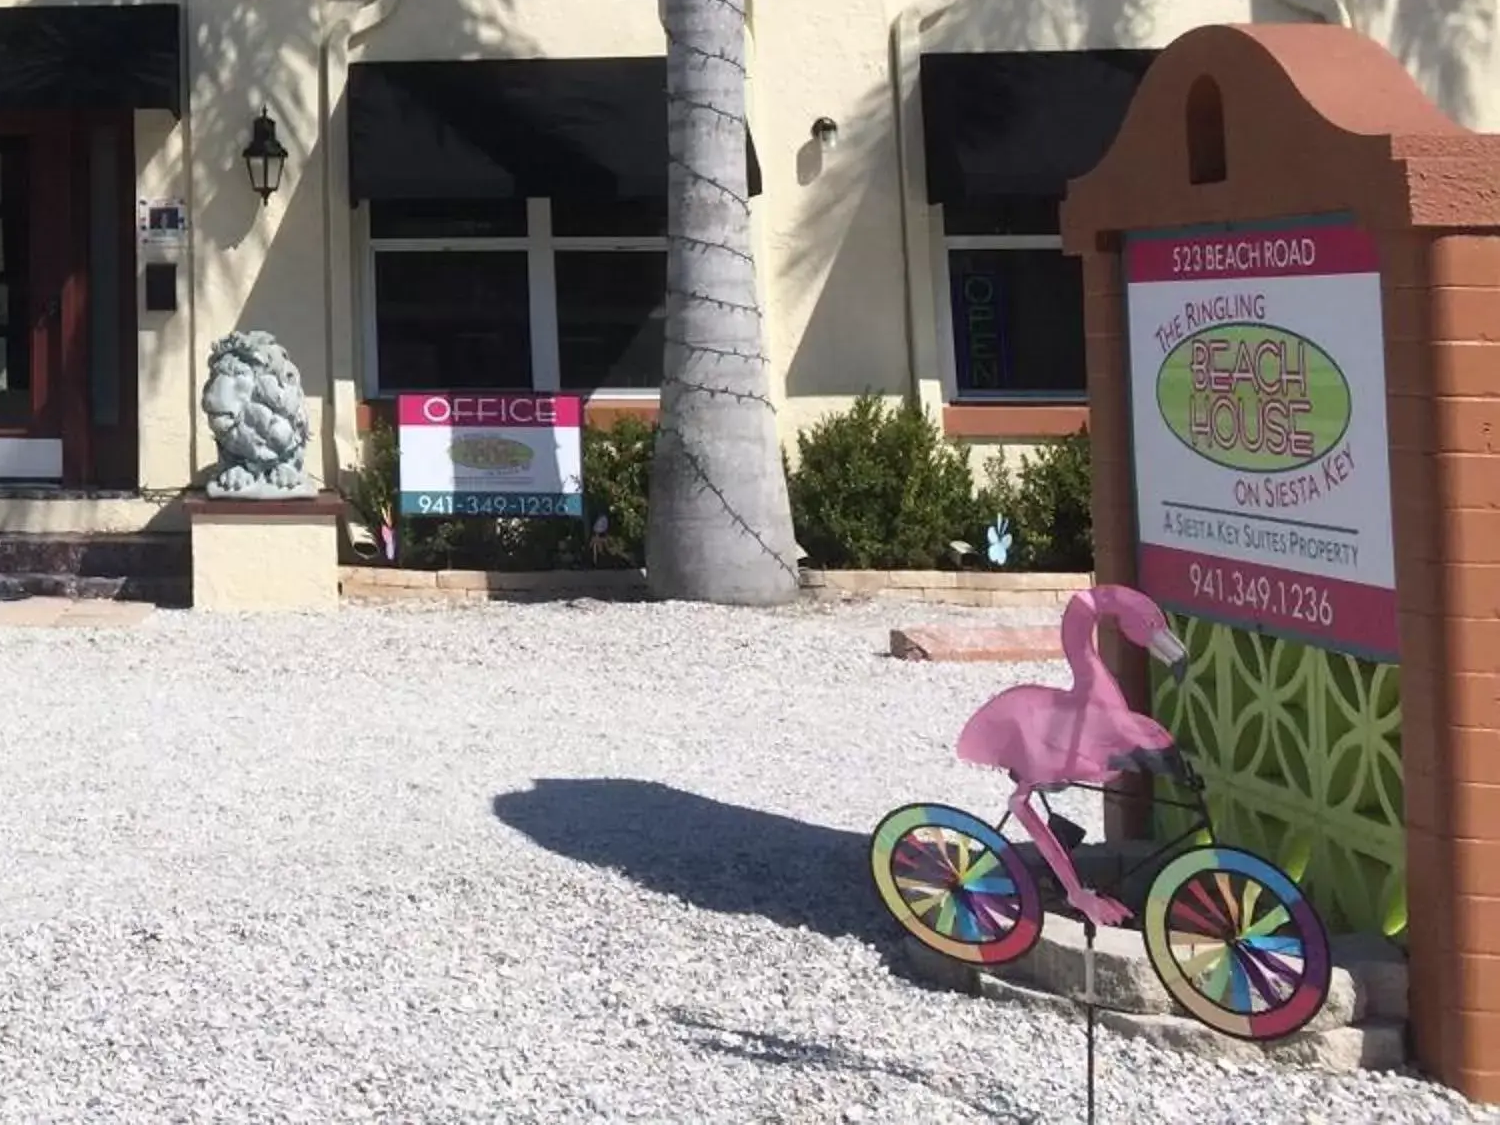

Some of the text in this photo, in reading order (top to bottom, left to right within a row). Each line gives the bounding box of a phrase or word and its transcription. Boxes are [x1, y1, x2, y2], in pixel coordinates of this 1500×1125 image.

[1173, 238, 1316, 272] 523 BEACH ROAD
[1155, 294, 1266, 353] THE RINGLING
[1191, 339, 1306, 397] BEACH
[423, 396, 557, 422] OFFICE
[1190, 394, 1315, 457] HOUSE
[1235, 442, 1355, 508] ON SIESTA KEY
[418, 495, 569, 515] 941-349-1236
[1163, 509, 1359, 567] A SIESTA KEY SUITES PROPERTY
[1189, 563, 1333, 626] 941.349.1236
